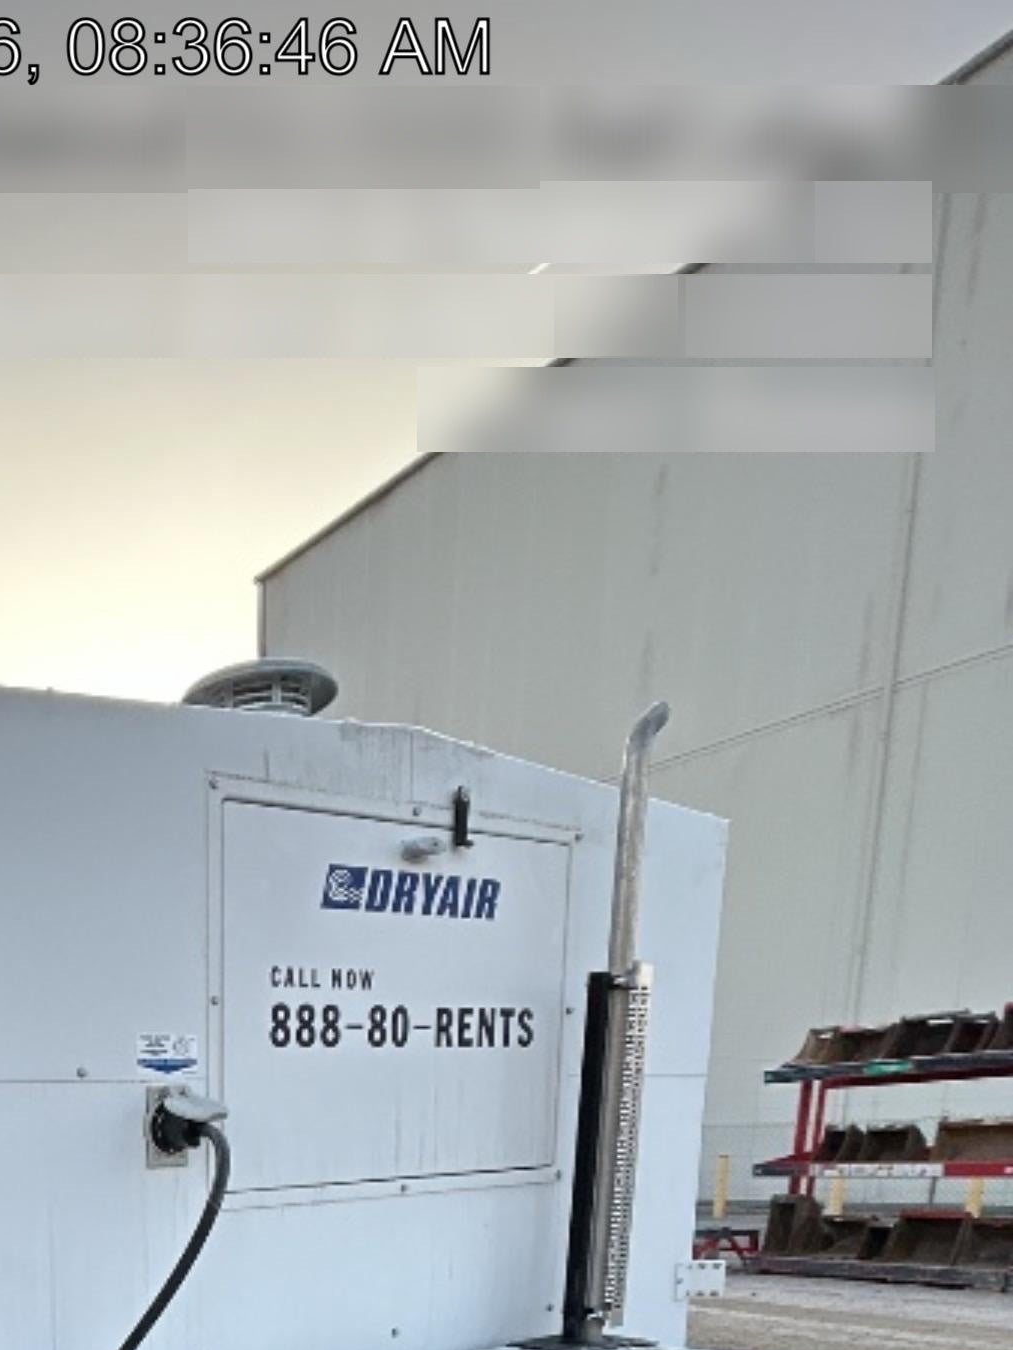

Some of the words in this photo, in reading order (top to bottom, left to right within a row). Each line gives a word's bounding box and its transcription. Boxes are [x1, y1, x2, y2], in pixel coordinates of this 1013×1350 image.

[363, 868, 502, 921] DRYAIR
[269, 965, 321, 989] CALL
[331, 968, 376, 991] NOW
[269, 1003, 535, 1050] 888-80-RENTS
